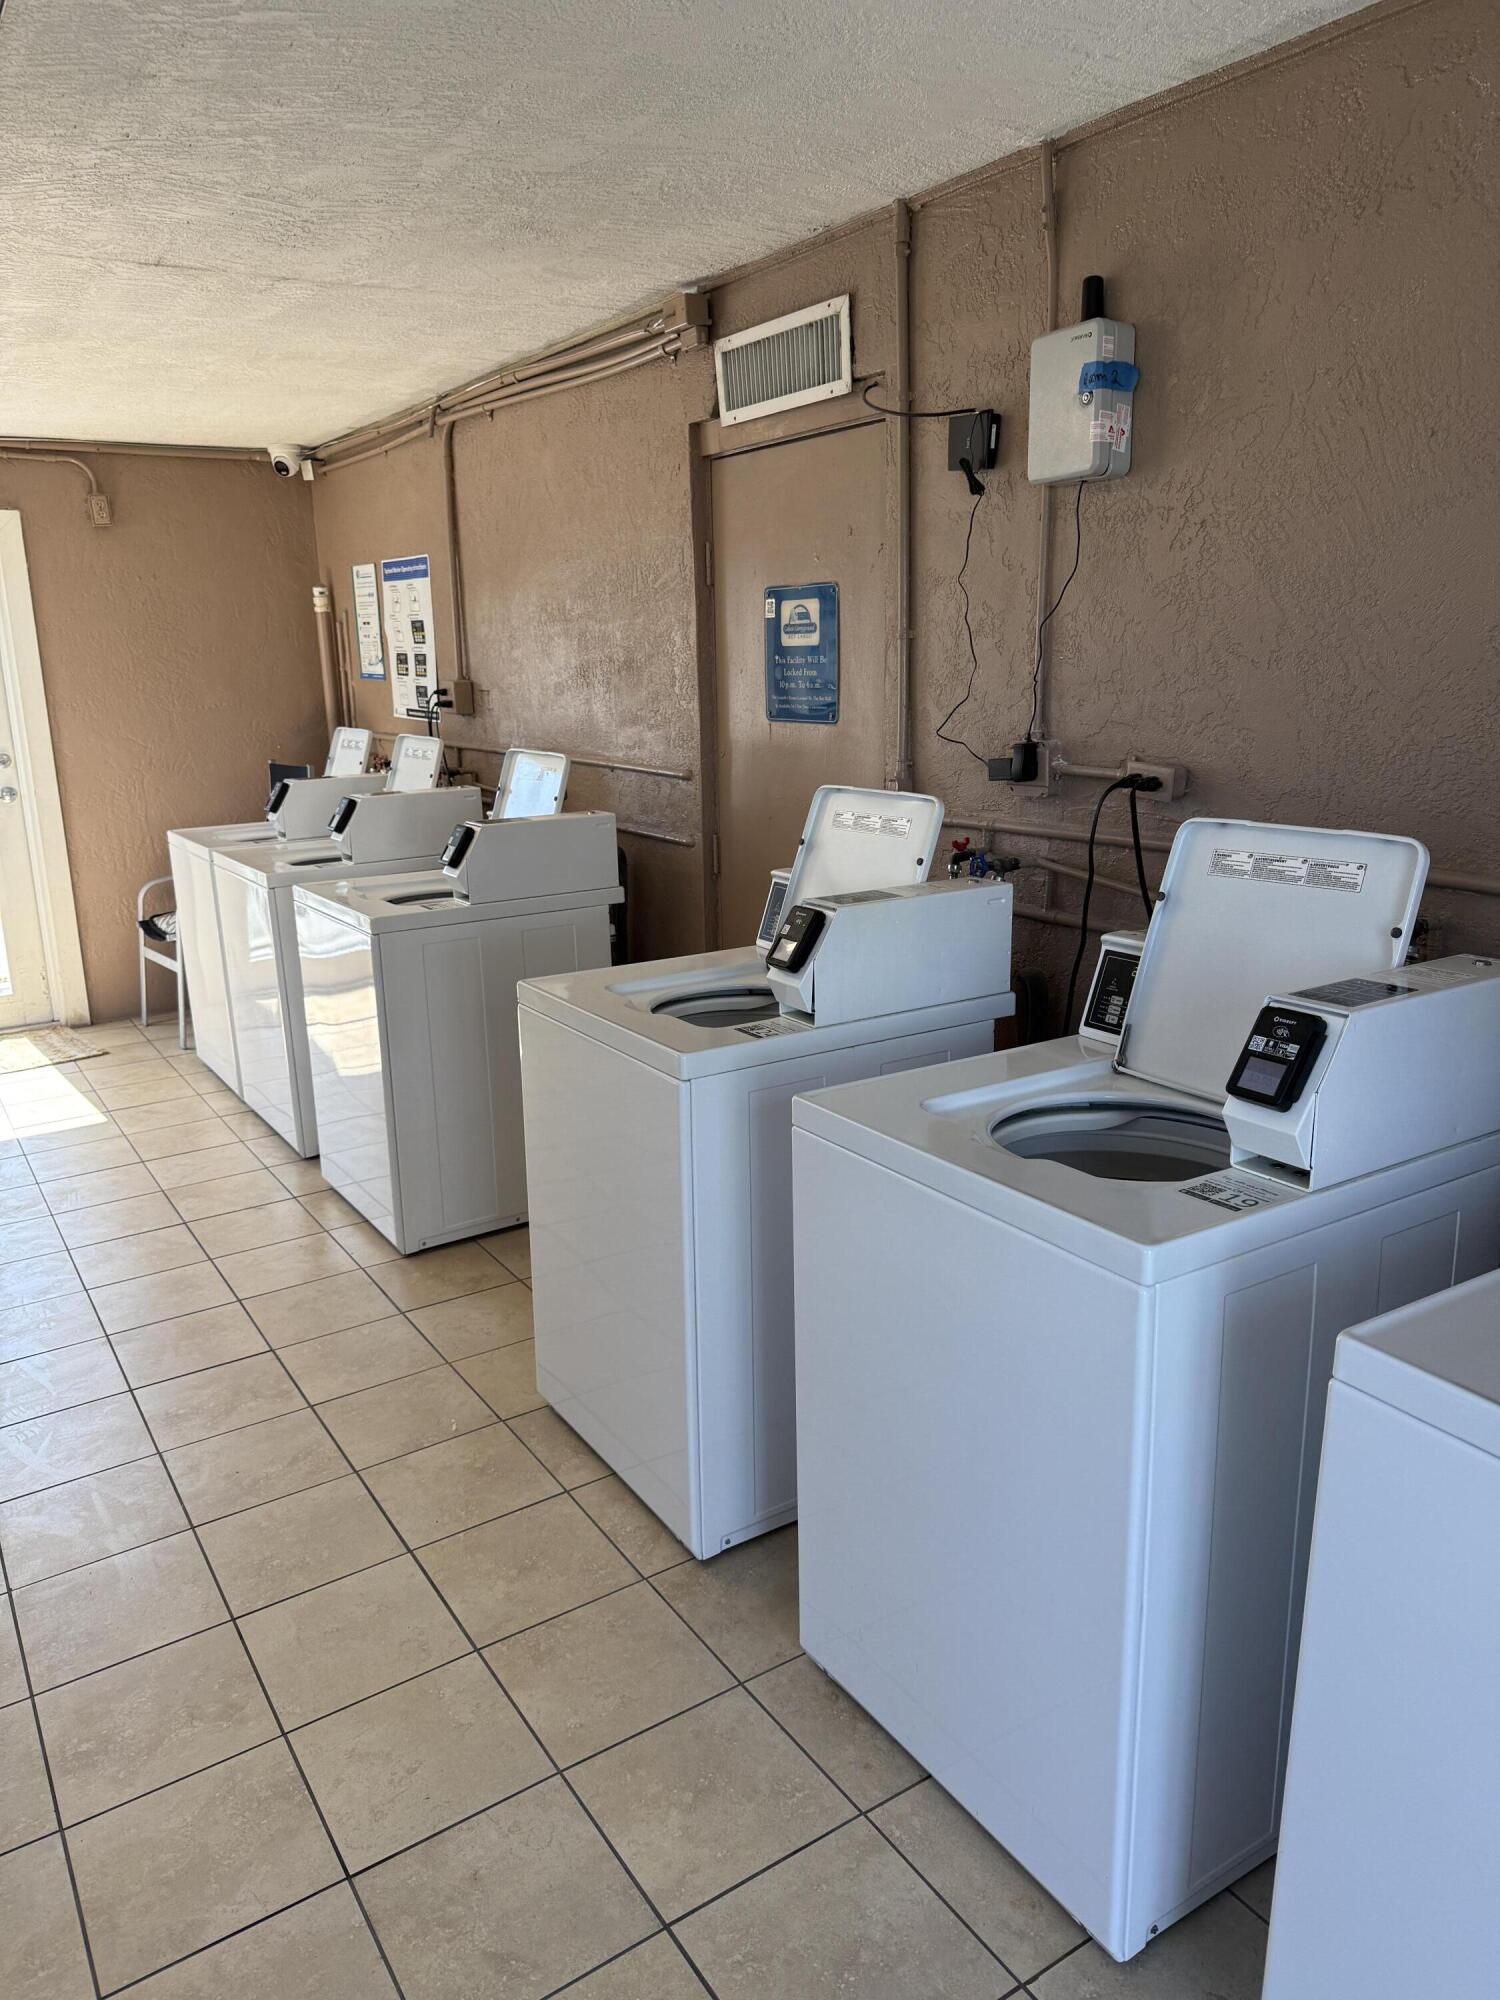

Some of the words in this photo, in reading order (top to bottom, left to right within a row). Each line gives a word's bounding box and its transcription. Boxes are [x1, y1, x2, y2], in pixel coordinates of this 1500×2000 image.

[775, 656, 786, 664] This
[787, 656, 805, 666] Facility
[807, 656, 818, 664] Will
[819, 656, 827, 664] Be
[784, 668, 802, 677] Locked
[803, 668, 817, 677] From
[1218, 1193, 1259, 1208] 19
